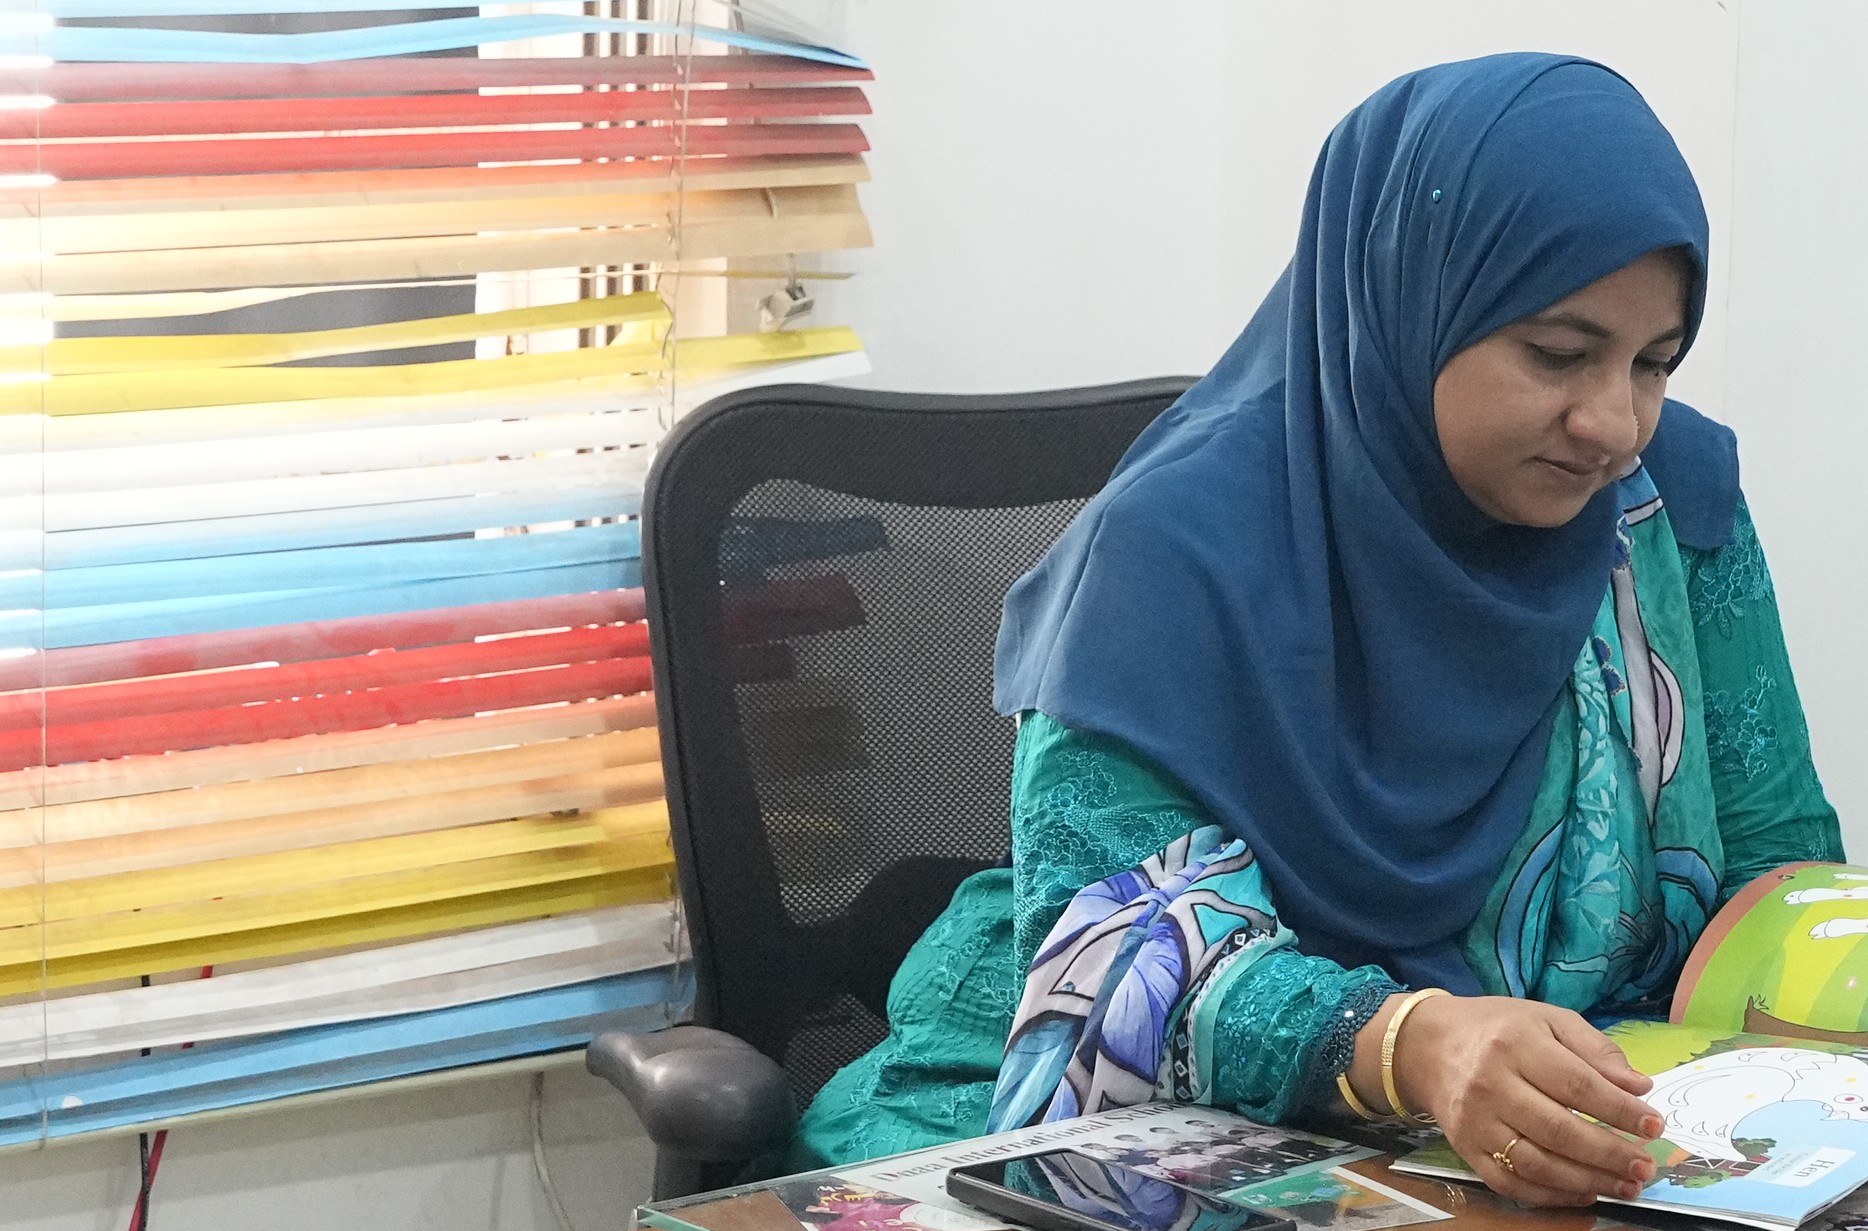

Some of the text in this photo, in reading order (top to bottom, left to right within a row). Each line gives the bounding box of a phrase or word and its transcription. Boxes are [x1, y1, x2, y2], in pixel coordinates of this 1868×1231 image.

[941, 1119, 1112, 1164] International
[1104, 1102, 1188, 1123] Schoo
[1794, 1159, 1836, 1178] Hen
